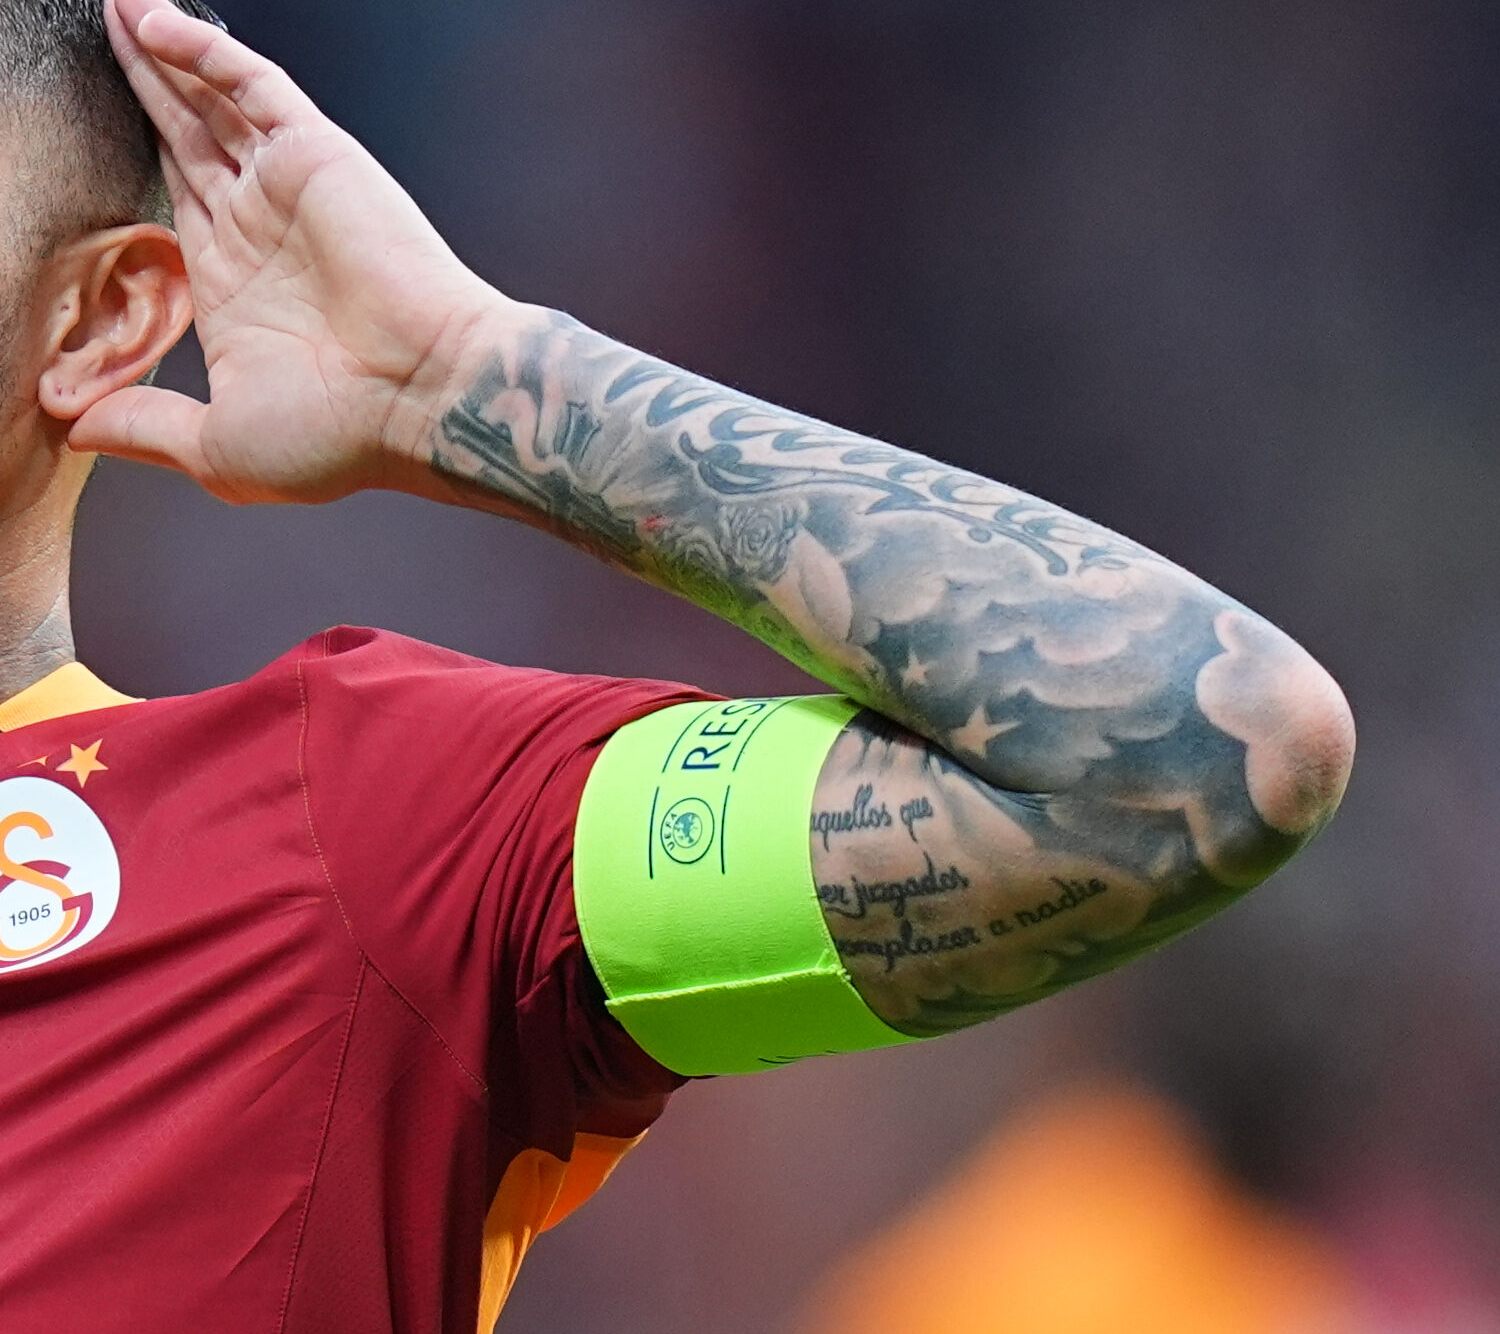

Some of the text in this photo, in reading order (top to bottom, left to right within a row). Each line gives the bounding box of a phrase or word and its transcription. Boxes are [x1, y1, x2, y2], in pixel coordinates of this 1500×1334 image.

[681, 699, 780, 770] RES
[664, 812, 677, 852] UEFA
[900, 796, 934, 843] que
[9, 904, 51, 927] 1905
[989, 919, 1014, 936] a
[1015, 876, 1108, 927] nadie
